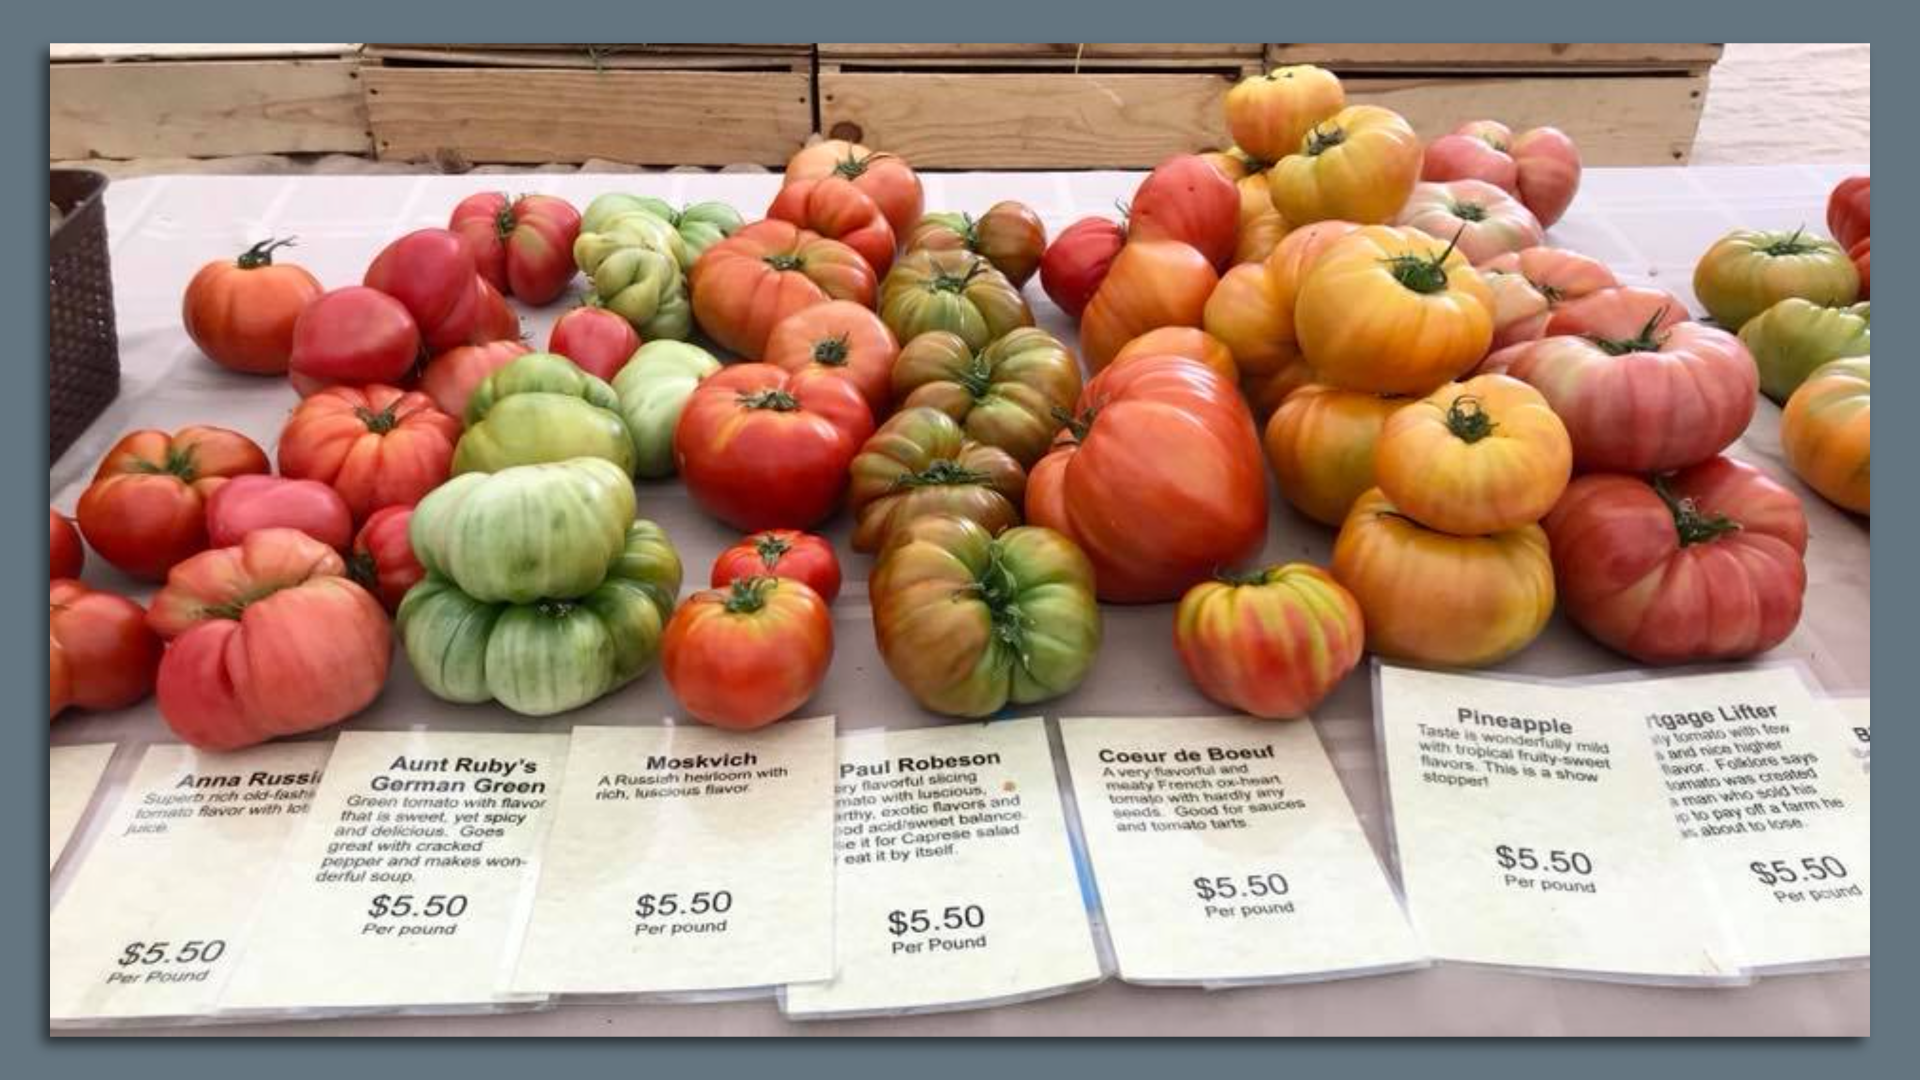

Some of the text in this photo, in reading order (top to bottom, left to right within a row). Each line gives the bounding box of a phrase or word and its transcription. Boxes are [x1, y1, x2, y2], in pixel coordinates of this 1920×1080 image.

[1457, 707, 1573, 735] Pineapple
[1718, 703, 1777, 722] Lifter
[1417, 723, 1610, 754] Taste is wonderfully mild
[1673, 729, 1726, 743] tomato
[1729, 726, 1760, 739] with
[1761, 723, 1790, 735] few
[1098, 748, 1167, 763] Coeur
[1173, 748, 1201, 762] de
[1418, 741, 1612, 770] with tropical fruity-sweet
[1668, 746, 1698, 759] and
[1699, 745, 1732, 756] nice
[1734, 740, 1782, 755] higher
[389, 755, 537, 777] Aunt Ruby's
[646, 752, 758, 770] Moskvich
[840, 751, 1001, 779] Paul Robeson
[1420, 754, 1598, 782] flavors. This is a show
[1714, 756, 1779, 771] Folklore
[1781, 752, 1819, 767] says
[176, 773, 241, 788] Anna
[598, 766, 789, 787] A Russian heirloom with
[1102, 763, 1249, 779] A very flavorful and
[1665, 768, 1818, 791] tomato was created
[370, 776, 546, 794] German Green
[861, 775, 924, 791] flavorful
[928, 771, 978, 786] slicing
[1105, 774, 1281, 792] meaty French ox-heart
[143, 792, 204, 806] Superb
[208, 791, 239, 802] rich
[346, 795, 547, 809] Green tomato with flavor
[595, 788, 630, 801] rich,
[634, 785, 700, 799] luscious
[881, 791, 914, 803] with
[1109, 787, 1285, 805] tomato with hardly any
[1682, 793, 1718, 807] man
[1719, 789, 1754, 803] who
[1756, 785, 1790, 799] sold
[1791, 784, 1818, 796] his
[135, 807, 194, 819] tomato
[198, 804, 244, 817] flavor
[249, 804, 282, 815] with
[881, 803, 929, 817] exotic
[932, 799, 986, 813] flavors
[990, 794, 1021, 808] and
[1174, 804, 1218, 817] Good
[1222, 803, 1243, 815] for
[1249, 798, 1306, 811] sauces
[1690, 809, 1710, 822] to
[1712, 807, 1742, 822] pay
[1745, 803, 1767, 817] off
[1769, 804, 1782, 814] a
[1782, 799, 1821, 813] farm
[1820, 797, 1845, 810] he
[340, 810, 372, 822] that
[376, 811, 390, 822] is
[454, 812, 479, 824] yet
[483, 812, 526, 826] spicy
[868, 817, 955, 833] acid/sweet
[959, 810, 1026, 826] balance.
[1116, 821, 1147, 832] and
[1151, 819, 1207, 832] tomato
[1700, 821, 1748, 838] about
[1747, 820, 1766, 832] to
[1767, 815, 1808, 831] lose.
[334, 825, 505, 837] and delicious. Goes
[860, 837, 871, 848] it
[874, 835, 897, 848] for
[900, 826, 971, 845] Caprese
[976, 824, 1020, 837] salad
[327, 840, 483, 853] great with cracked
[844, 852, 872, 864] eat
[875, 850, 886, 861] it
[890, 848, 911, 862] by
[321, 855, 527, 869] pepper and makes won-
[1495, 844, 1592, 875] $5.50
[315, 870, 416, 884] derful soup.
[1750, 855, 1847, 886] $5.50
[1193, 872, 1289, 901] $5.50
[1504, 874, 1596, 894] Per pound
[1773, 883, 1863, 903] Per pound
[367, 893, 468, 919] $5.50
[634, 890, 733, 918] $5.50
[1204, 900, 1295, 918] Per pound
[361, 922, 457, 936] Per pound
[634, 919, 728, 937] Per pound
[887, 904, 985, 936] $5.50
[117, 939, 226, 967] $5.50
[891, 935, 987, 954] Per Pound
[106, 969, 209, 984] Per Pound
